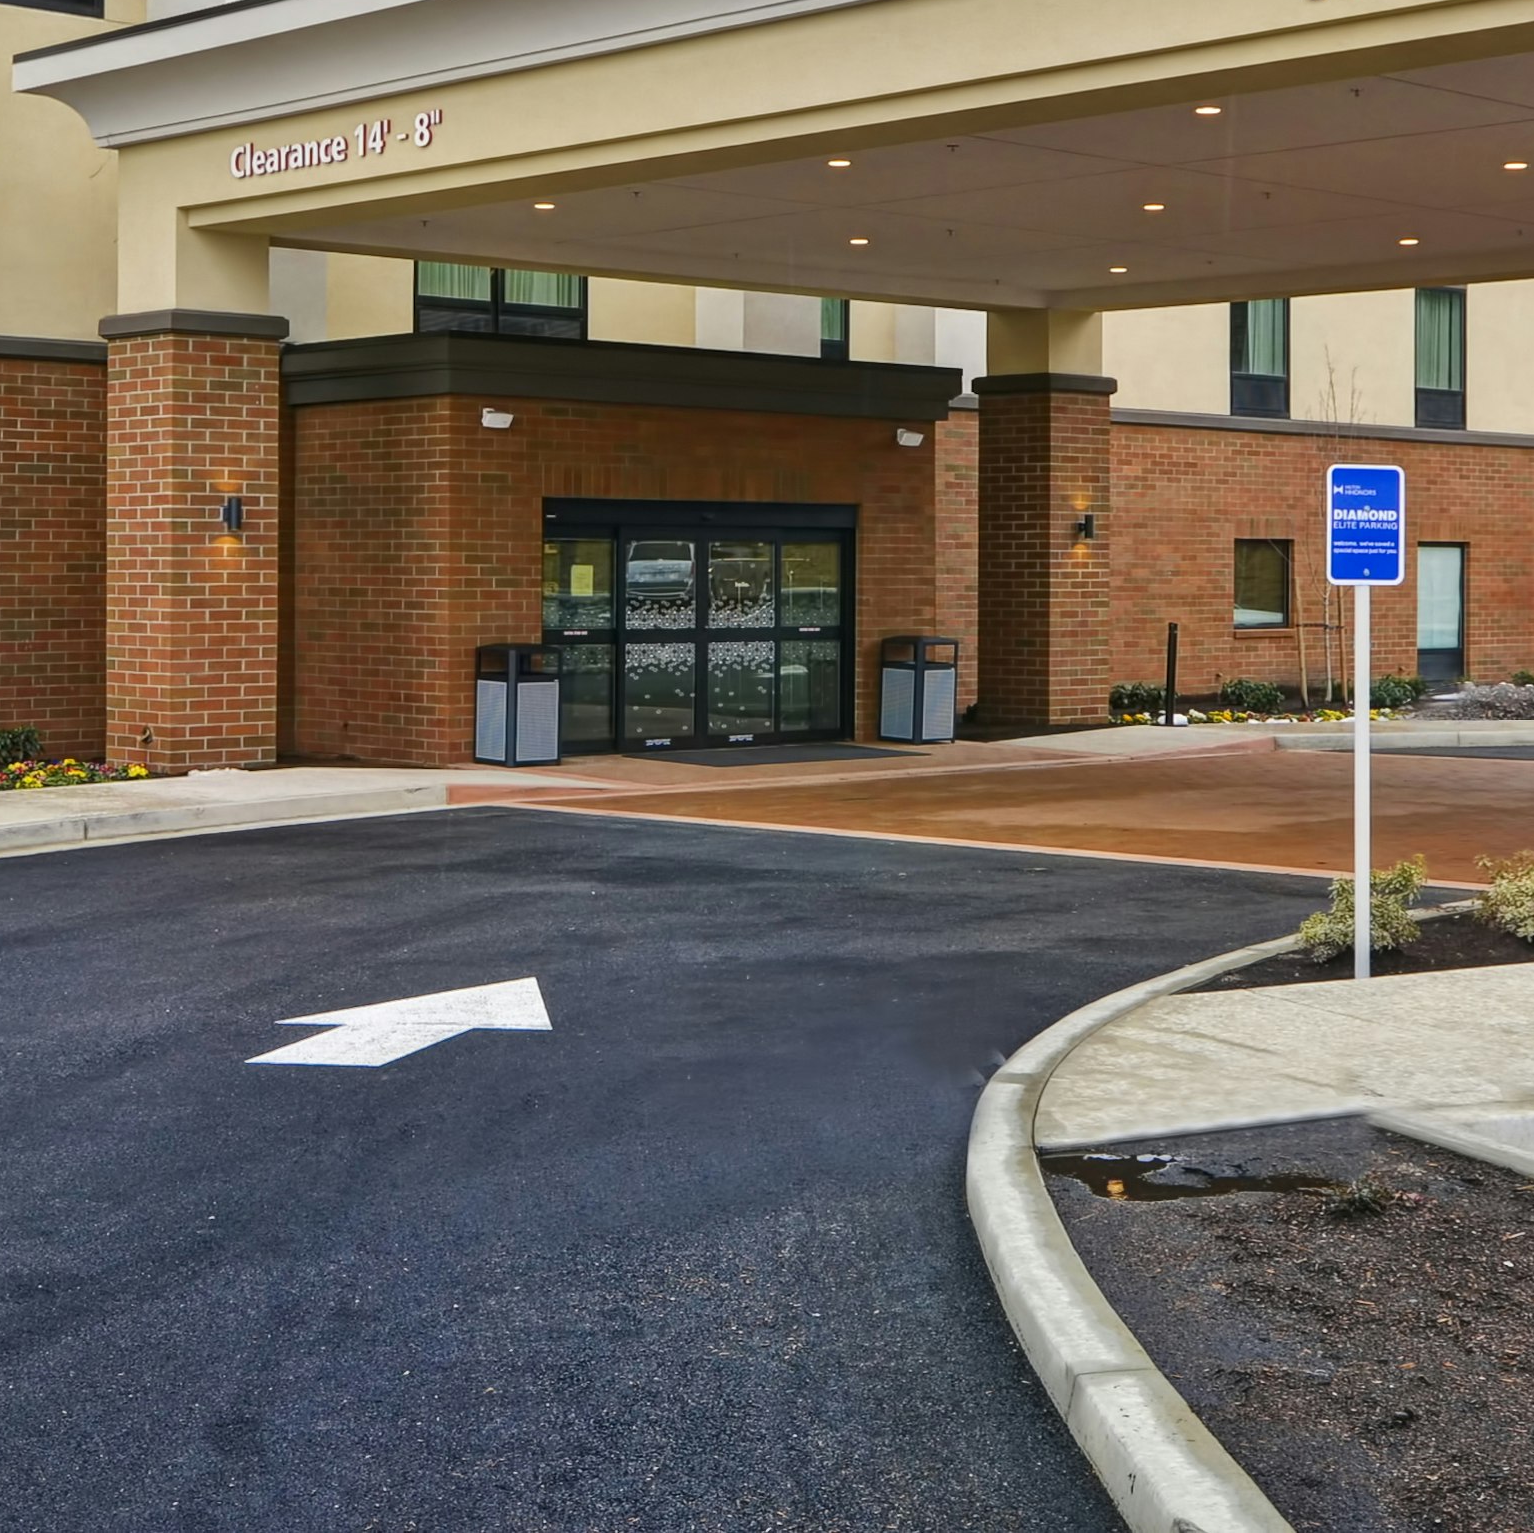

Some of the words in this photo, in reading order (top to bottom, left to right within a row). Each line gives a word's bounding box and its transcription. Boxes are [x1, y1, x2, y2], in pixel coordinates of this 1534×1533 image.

[230, 135, 348, 179] Clearance
[354, 119, 390, 157] 14'
[1333, 509, 1397, 521] DIAMOND
[1333, 521, 1358, 529] ELITE
[1359, 522, 1398, 530] PARKING
